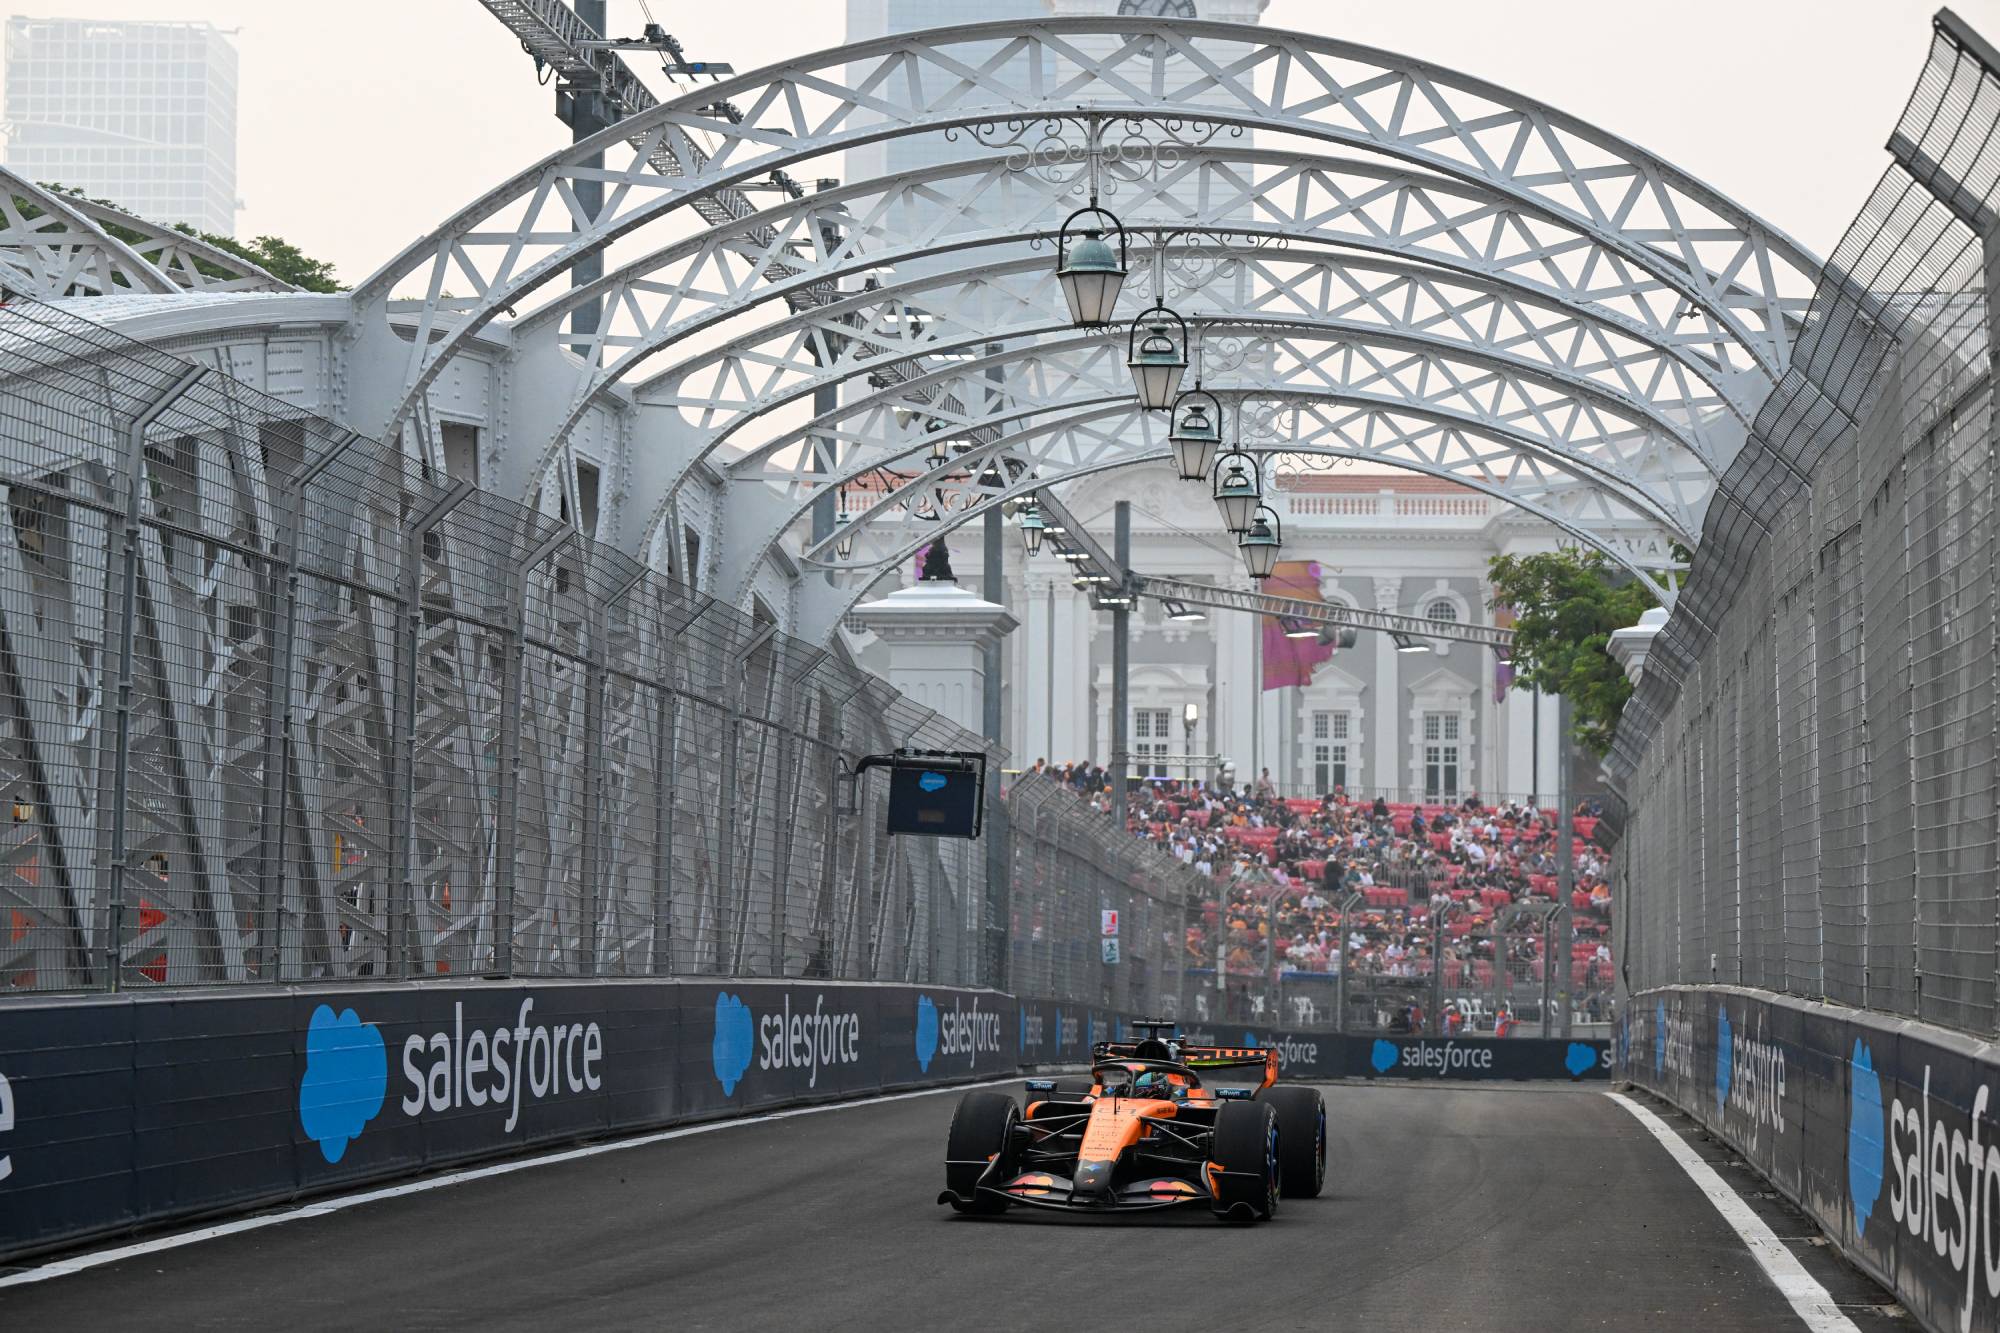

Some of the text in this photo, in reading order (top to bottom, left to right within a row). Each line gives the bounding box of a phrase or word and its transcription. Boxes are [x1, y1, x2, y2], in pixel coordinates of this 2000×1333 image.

[402, 998, 602, 1132] salesforce
[760, 994, 859, 1087] salesforce
[941, 996, 1000, 1067] salesforce
[1402, 1039, 1493, 1074] salesforce
[1731, 1009, 1786, 1151] salesforce
